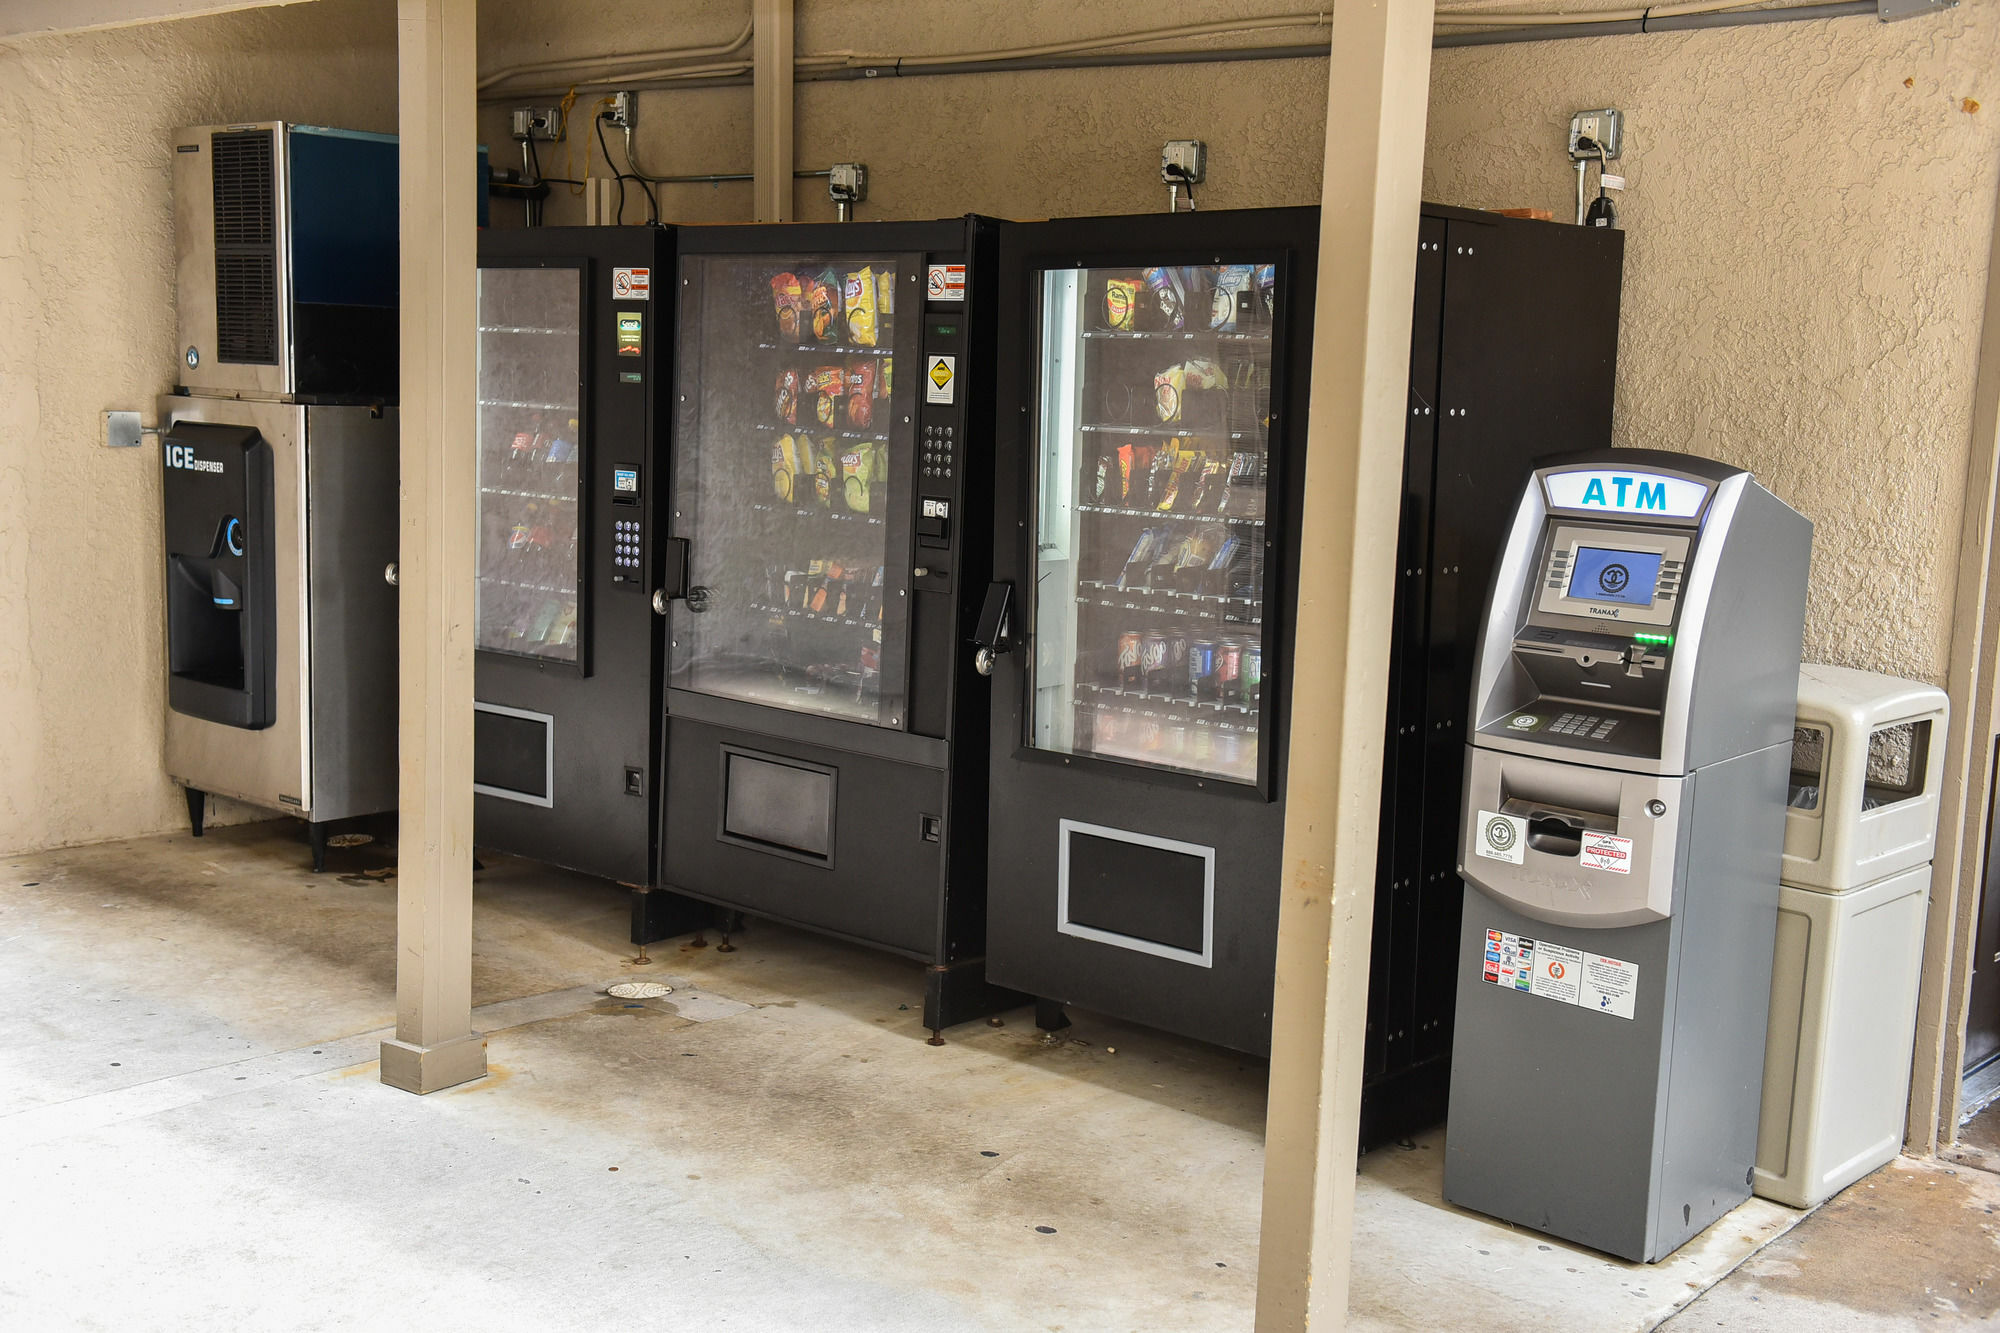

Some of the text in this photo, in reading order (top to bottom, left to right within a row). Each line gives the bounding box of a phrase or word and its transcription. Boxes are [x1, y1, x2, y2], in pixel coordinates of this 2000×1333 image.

[166, 444, 224, 473] ICE DISPENSER
[1582, 477, 1667, 511] ATM
[1589, 607, 1619, 618] TRANAX
[1586, 846, 1626, 859] PROTECTED
